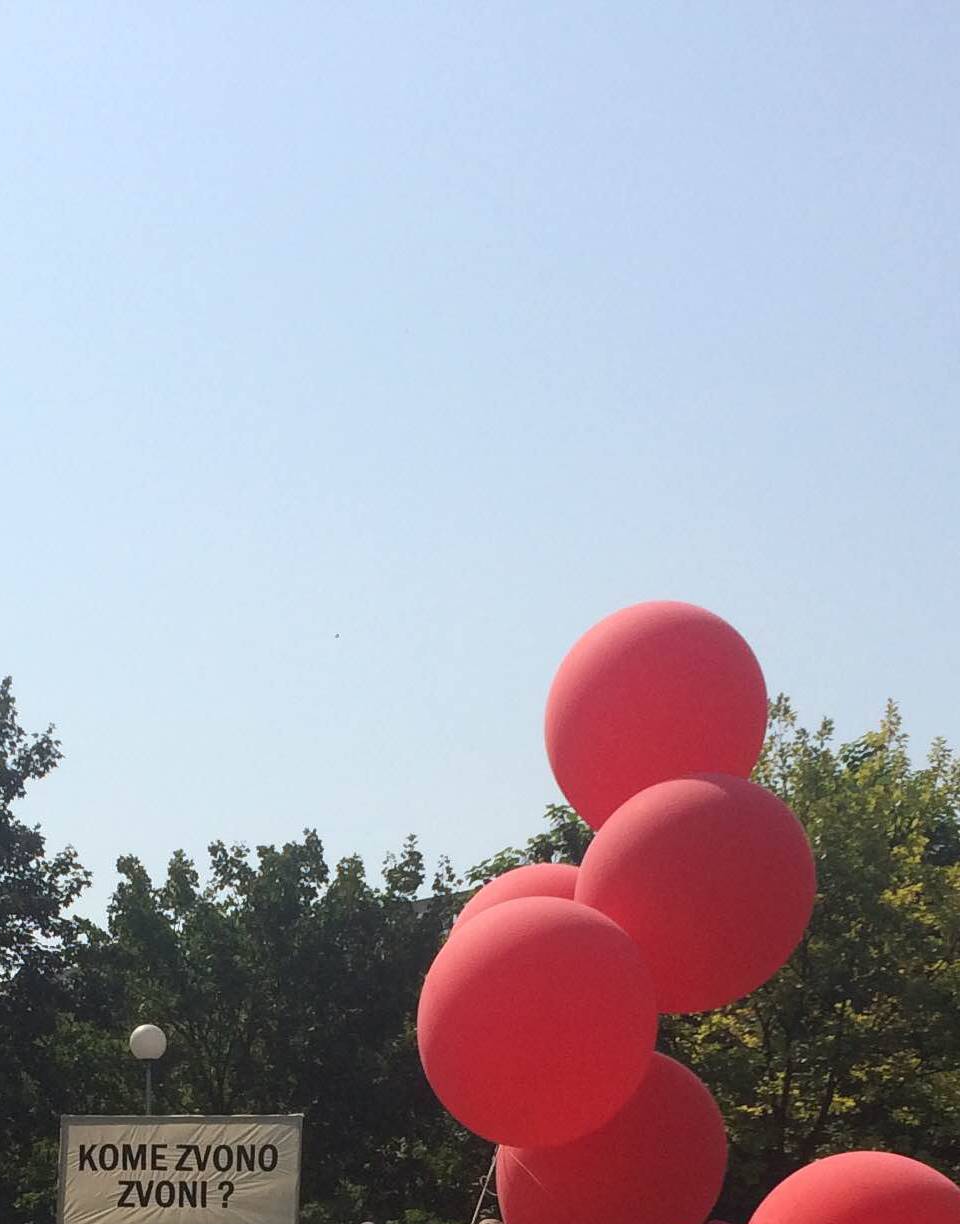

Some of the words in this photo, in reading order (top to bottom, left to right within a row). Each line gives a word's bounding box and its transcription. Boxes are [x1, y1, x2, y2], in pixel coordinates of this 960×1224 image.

[78, 1144, 168, 1172] KOME
[175, 1144, 279, 1172] ZVONO
[117, 1180, 207, 1208] ZVONI
[218, 1181, 235, 1208] ?
